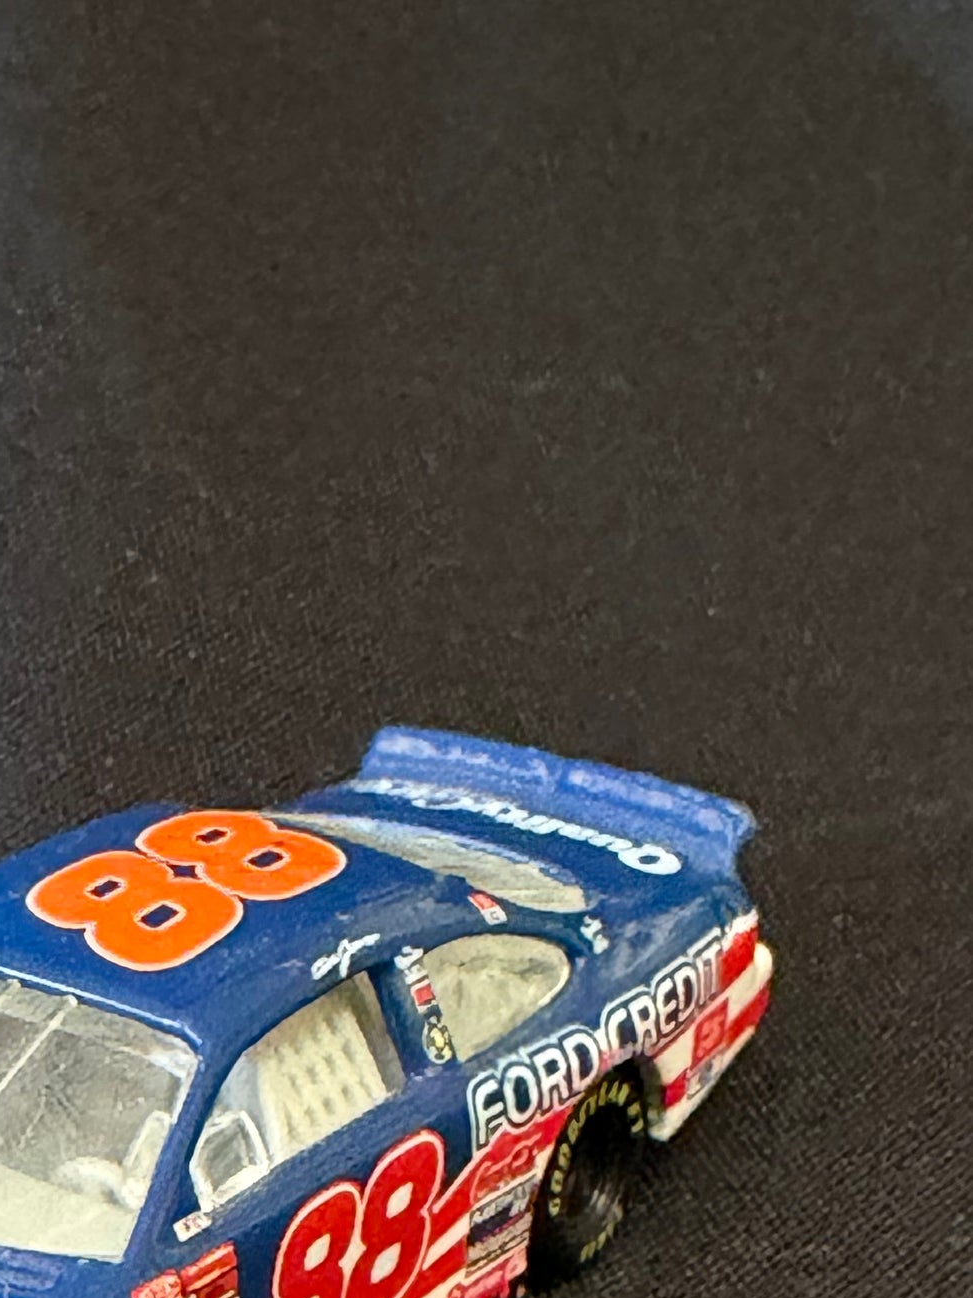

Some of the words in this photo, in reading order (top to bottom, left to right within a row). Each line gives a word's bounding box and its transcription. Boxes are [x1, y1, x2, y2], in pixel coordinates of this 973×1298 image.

[26, 810, 348, 972] 88
[467, 1026, 604, 1157] FORD
[600, 927, 725, 1068] CREDIT
